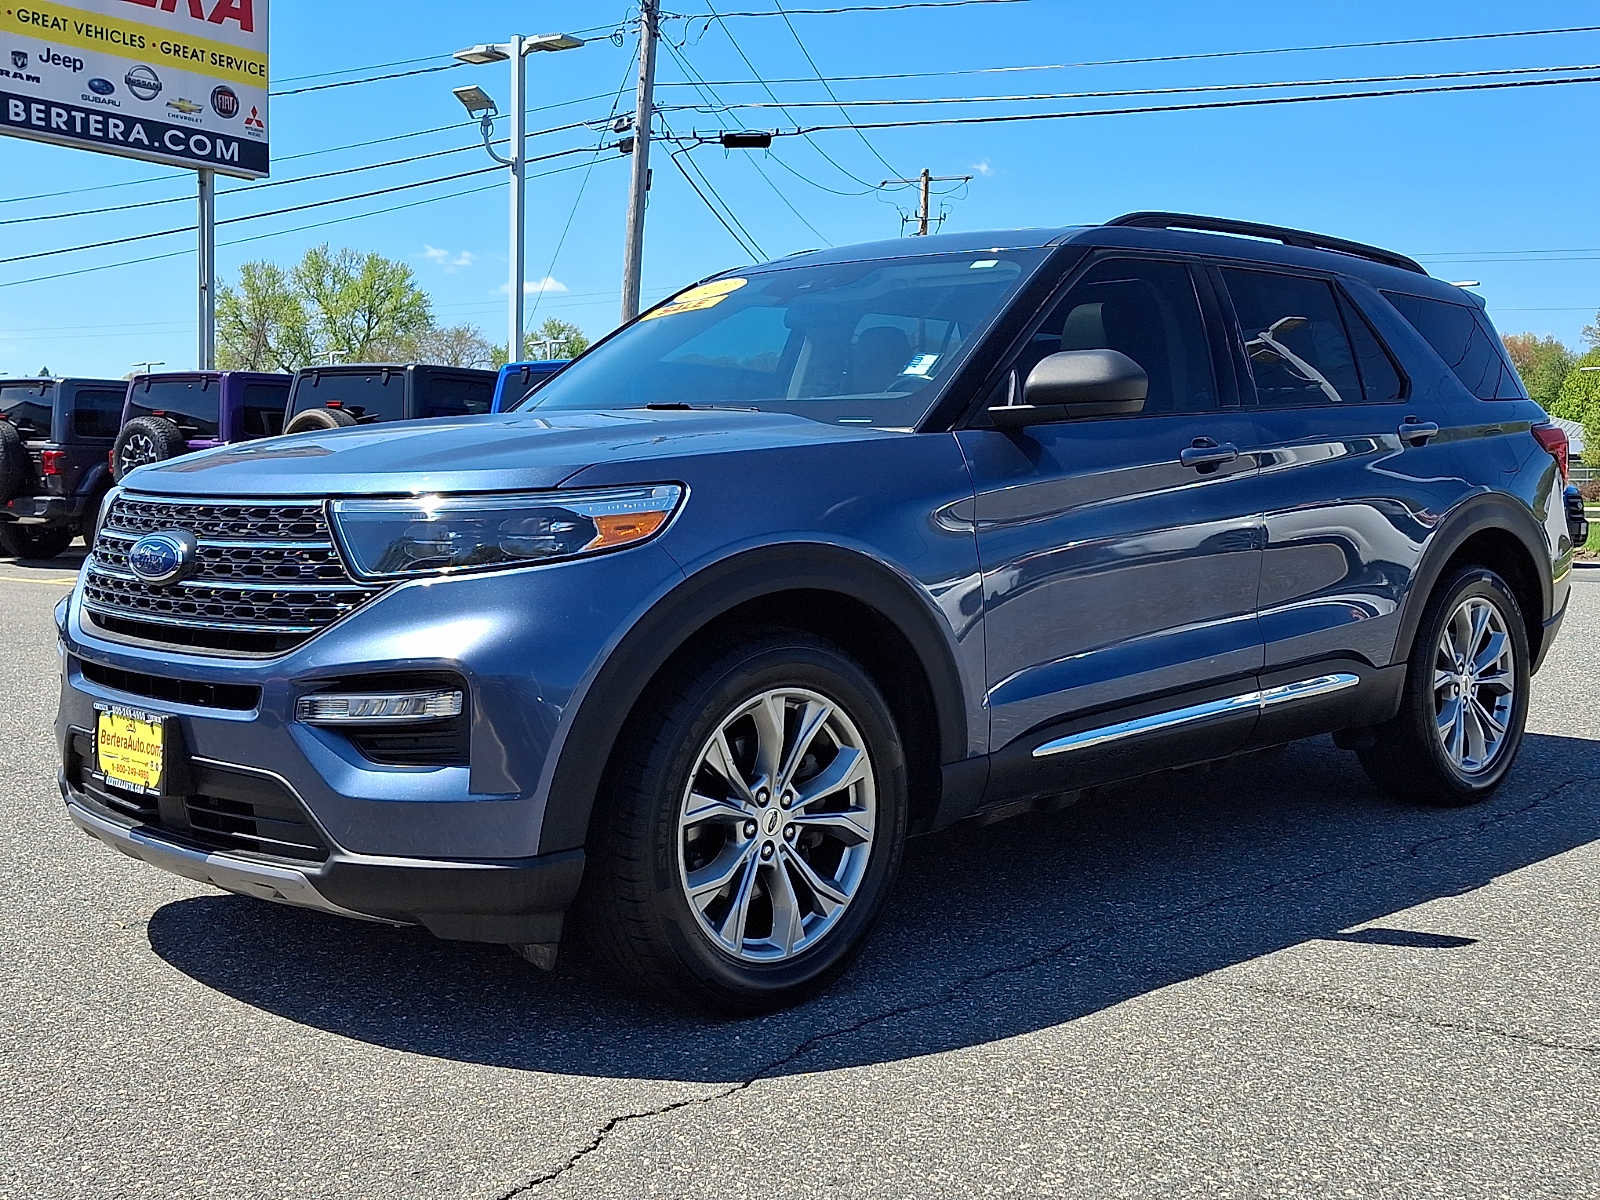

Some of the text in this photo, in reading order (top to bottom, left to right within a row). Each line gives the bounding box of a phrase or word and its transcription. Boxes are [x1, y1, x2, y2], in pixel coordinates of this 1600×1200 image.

[16, 8, 266, 77] GREAT VEHICLES GREAT SERVICE
[38, 47, 84, 73] Jeep
[0, 68, 41, 84] RAM
[127, 77, 161, 90] NISSAN
[80, 93, 121, 108] SUBARU
[217, 94, 234, 111] FIAT
[167, 112, 203, 123] CHEVROLET
[8, 98, 239, 162] BERTERA.COM
[100, 729, 161, 758] BerteraAuto.com
